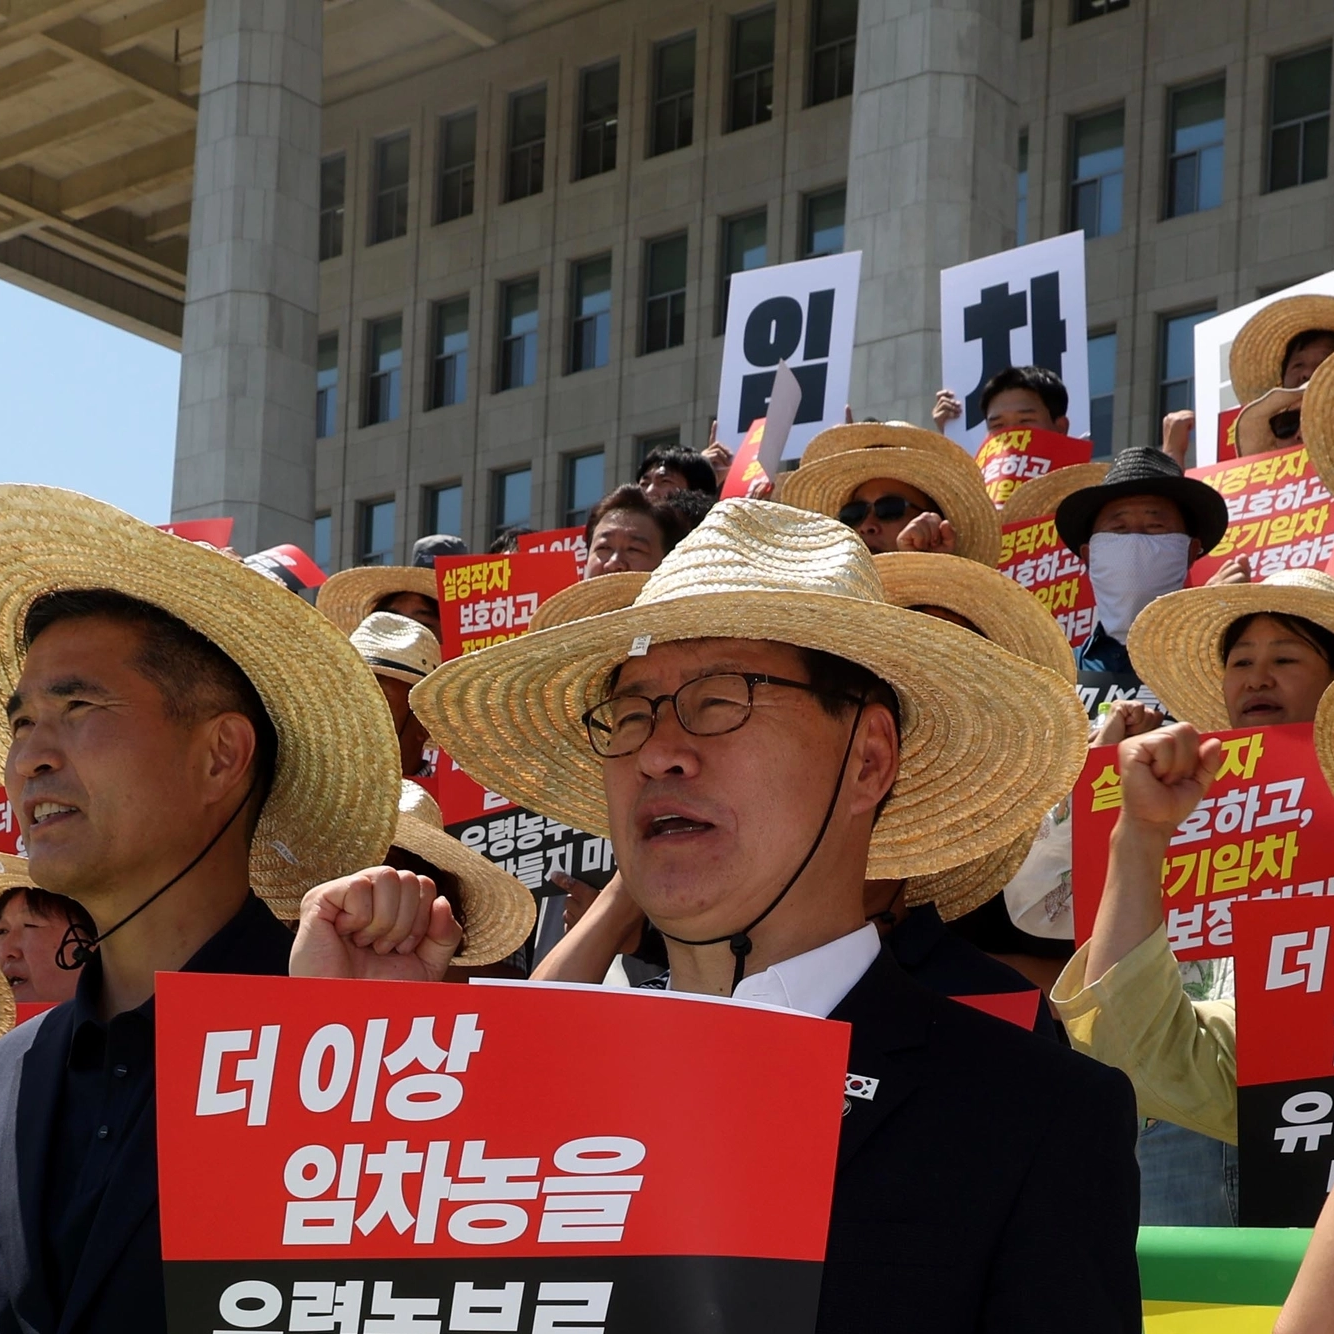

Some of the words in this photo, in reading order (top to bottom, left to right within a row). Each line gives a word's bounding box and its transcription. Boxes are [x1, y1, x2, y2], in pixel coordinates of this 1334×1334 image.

[443, 559, 511, 601] 실경작자
[1265, 926, 1331, 993] 더
[196, 1025, 281, 1126] 더
[298, 1013, 485, 1122] 이상
[281, 1135, 647, 1245] 임차농을
